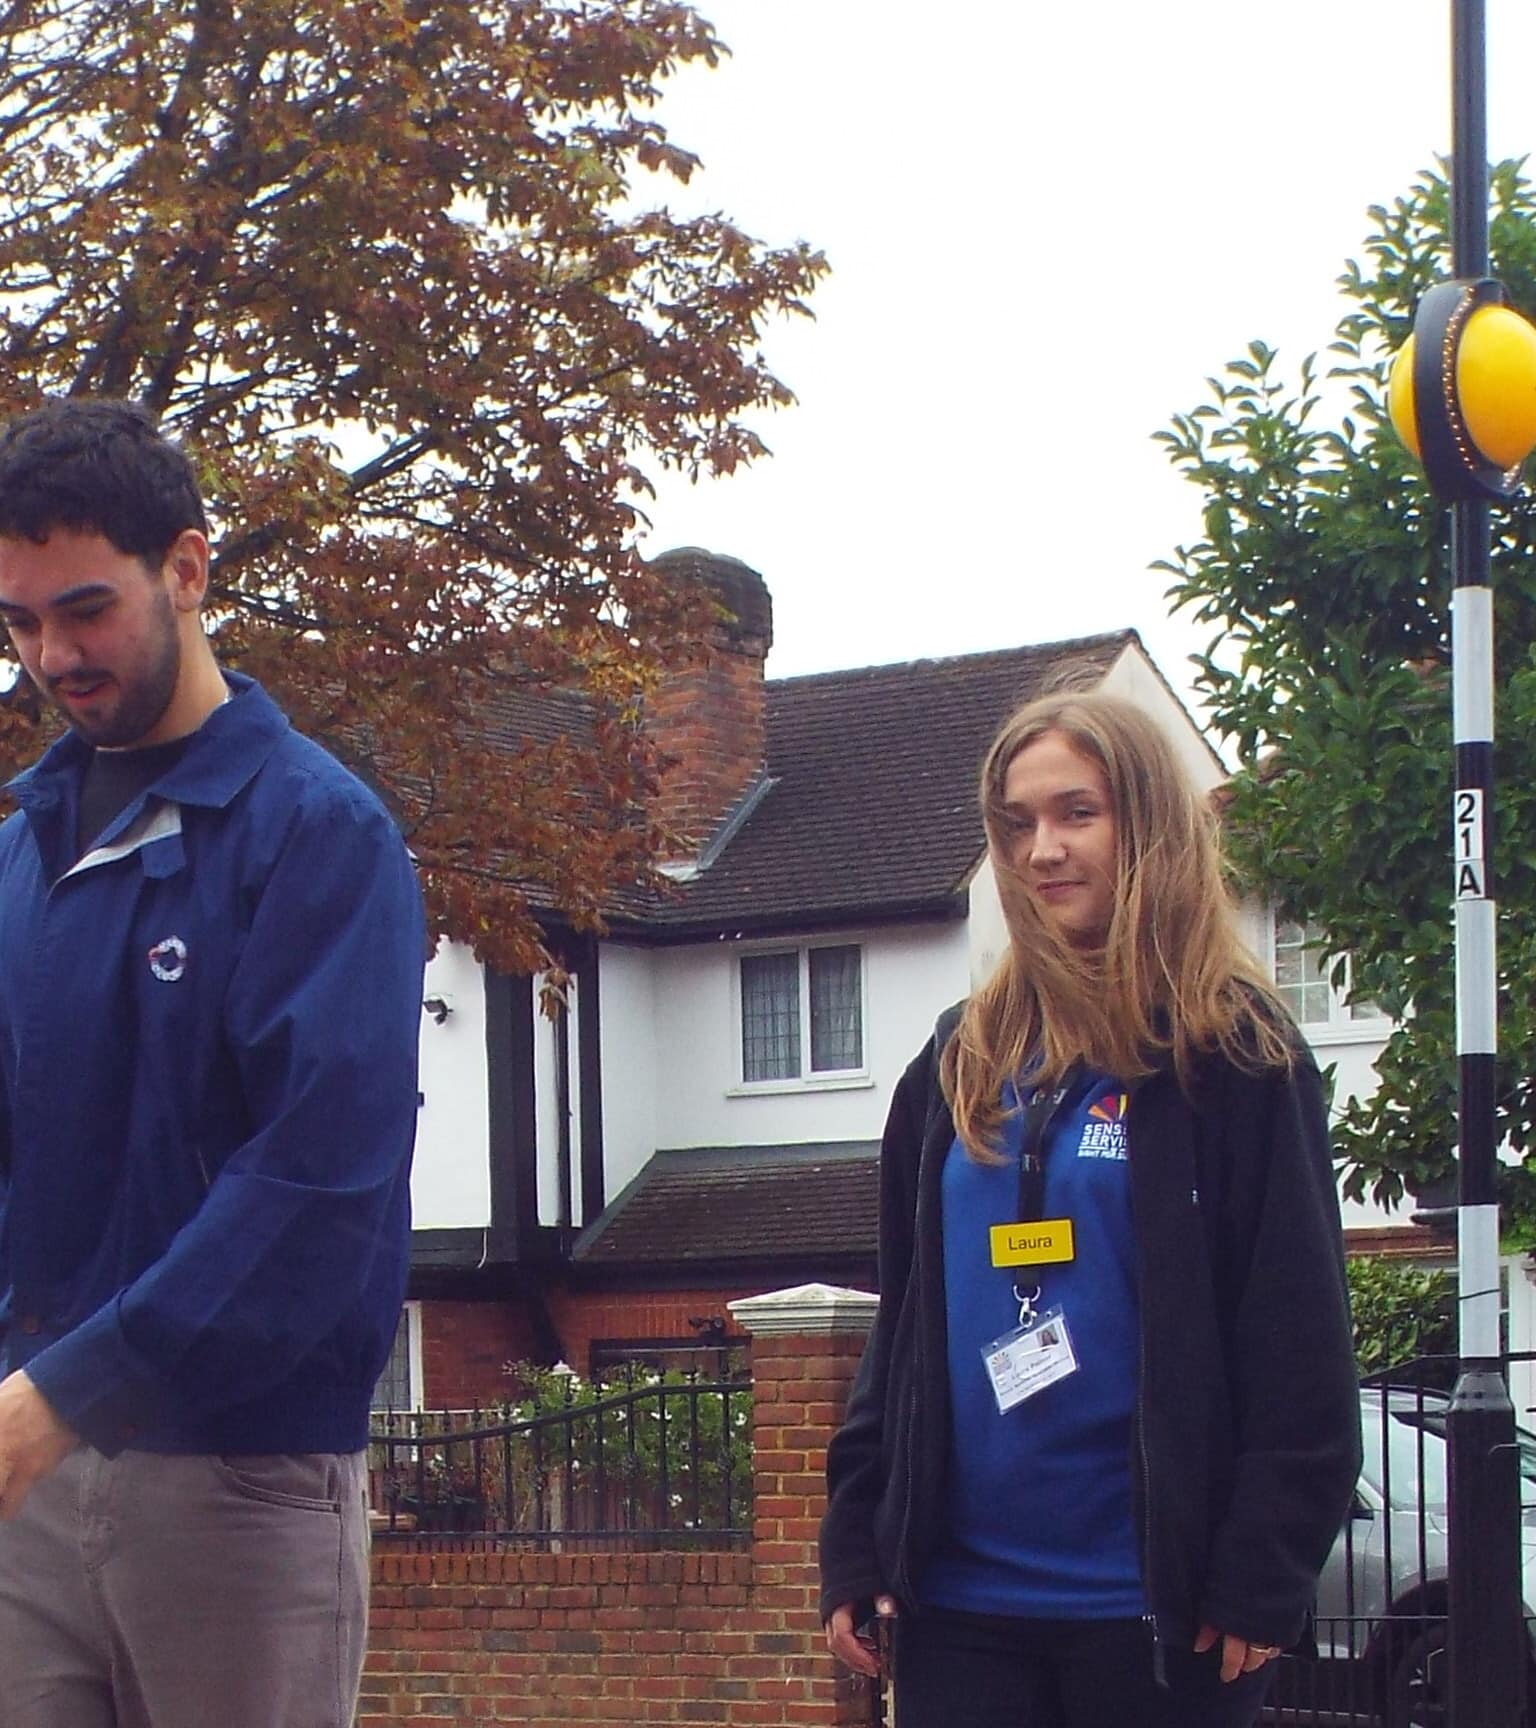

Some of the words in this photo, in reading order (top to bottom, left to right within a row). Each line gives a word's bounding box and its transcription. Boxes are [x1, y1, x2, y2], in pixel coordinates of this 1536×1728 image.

[1083, 1122, 1127, 1136] SENS
[1080, 1135, 1127, 1148] SERVI
[1009, 1236, 1052, 1251] Laura
